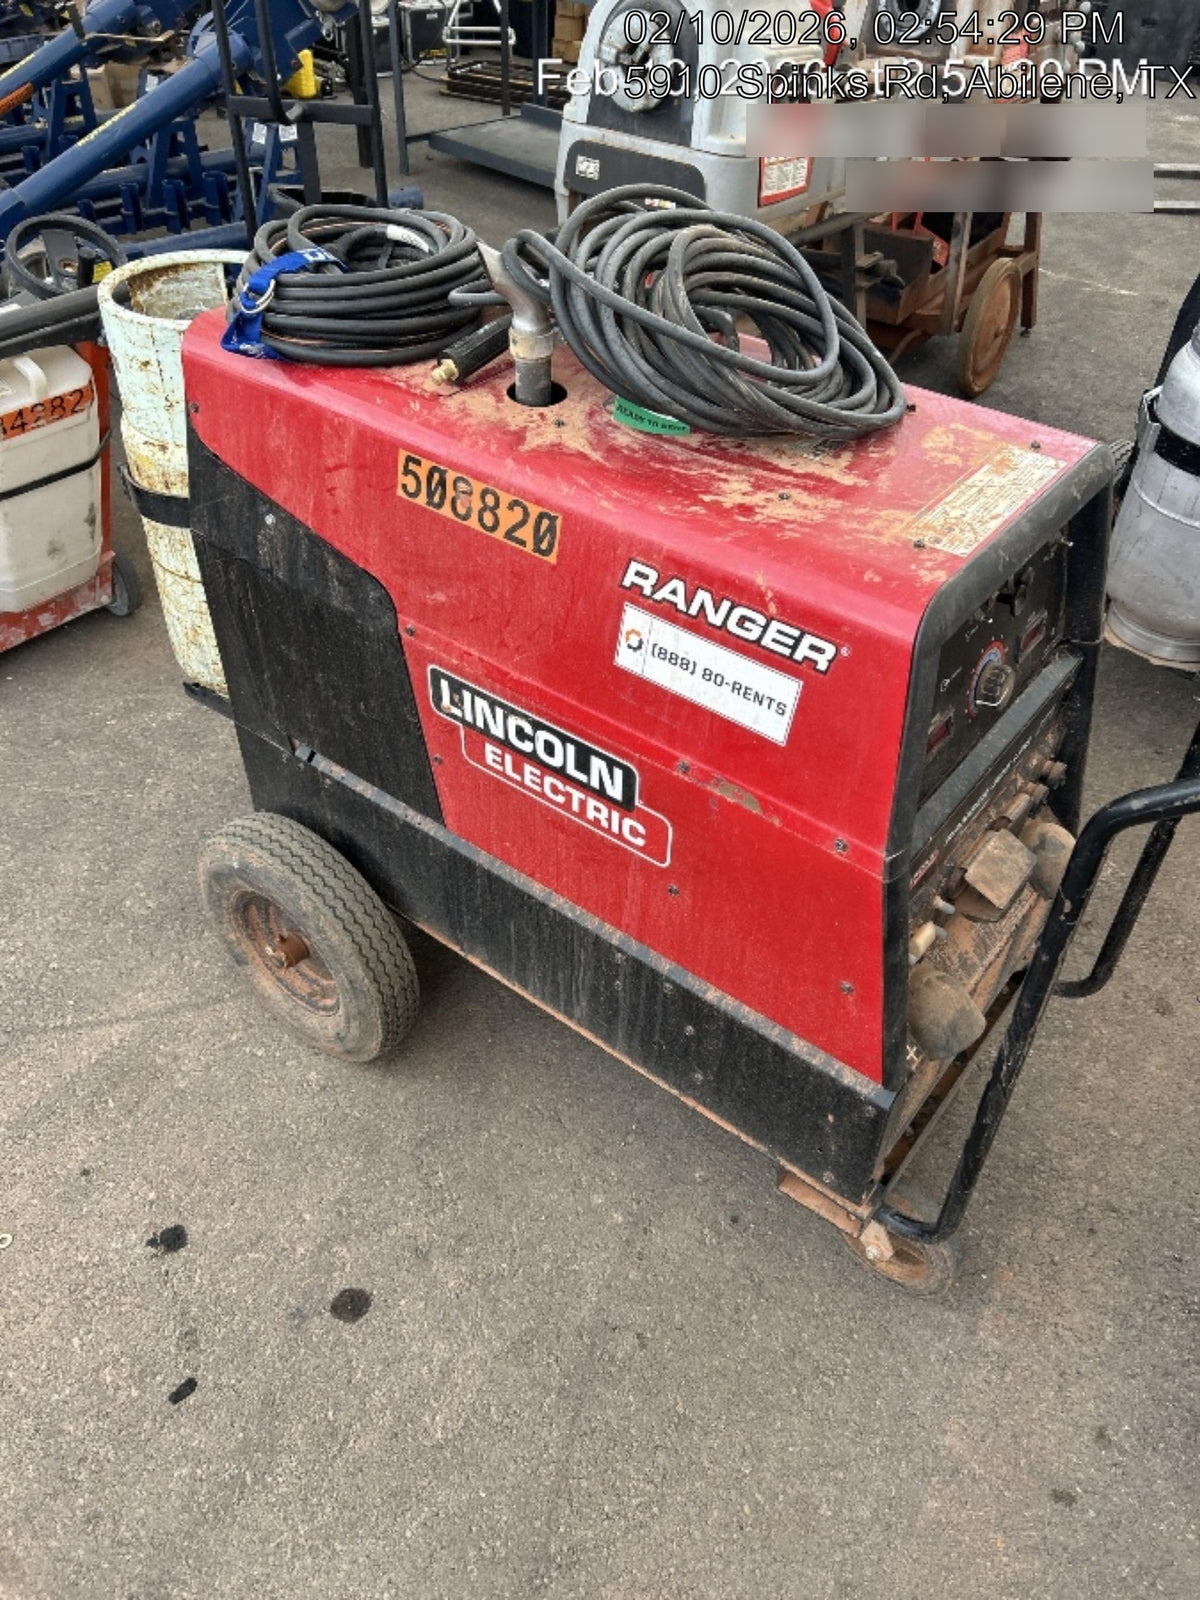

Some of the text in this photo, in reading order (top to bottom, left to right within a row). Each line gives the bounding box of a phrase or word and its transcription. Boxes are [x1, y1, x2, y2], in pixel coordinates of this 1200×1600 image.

[400, 454, 560, 559] 508820
[620, 559, 838, 673] RANGER
[651, 643, 788, 717] (888) 80-RENTS
[438, 680, 626, 803] LINCOLN
[484, 743, 648, 848] ELECTRIC
